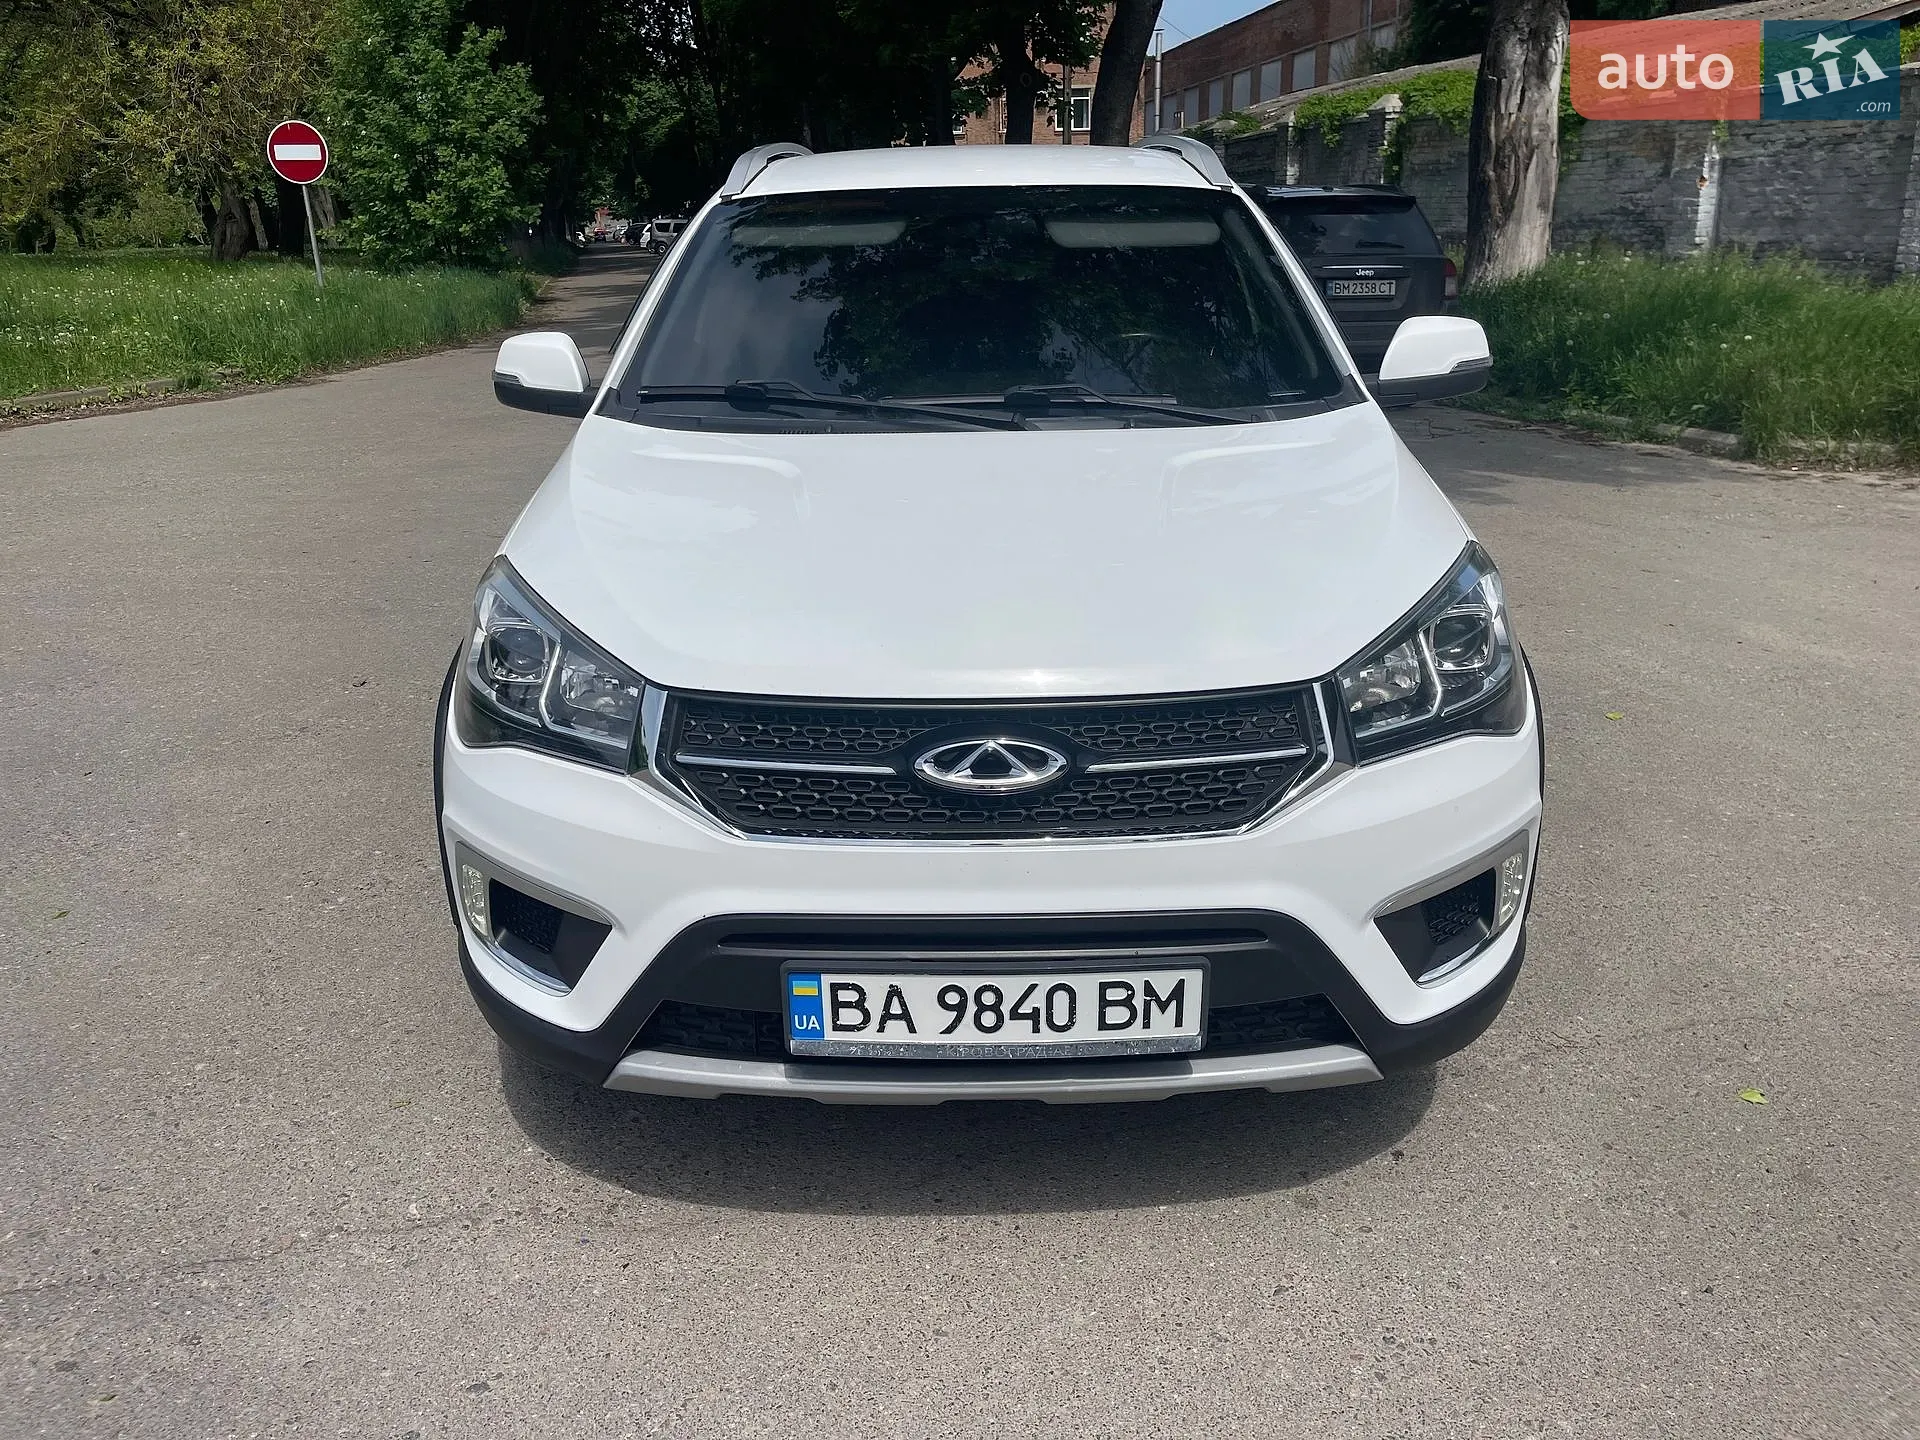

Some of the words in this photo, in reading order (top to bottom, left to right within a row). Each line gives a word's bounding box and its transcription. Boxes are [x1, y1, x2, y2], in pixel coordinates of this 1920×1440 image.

[1334, 283, 1350, 294] BM
[1352, 283, 1377, 294] 2358
[1379, 282, 1394, 293] CT
[830, 982, 917, 1034] BA
[936, 982, 1077, 1035] 9840
[1097, 979, 1186, 1030] BM
[794, 1014, 821, 1030] UA
